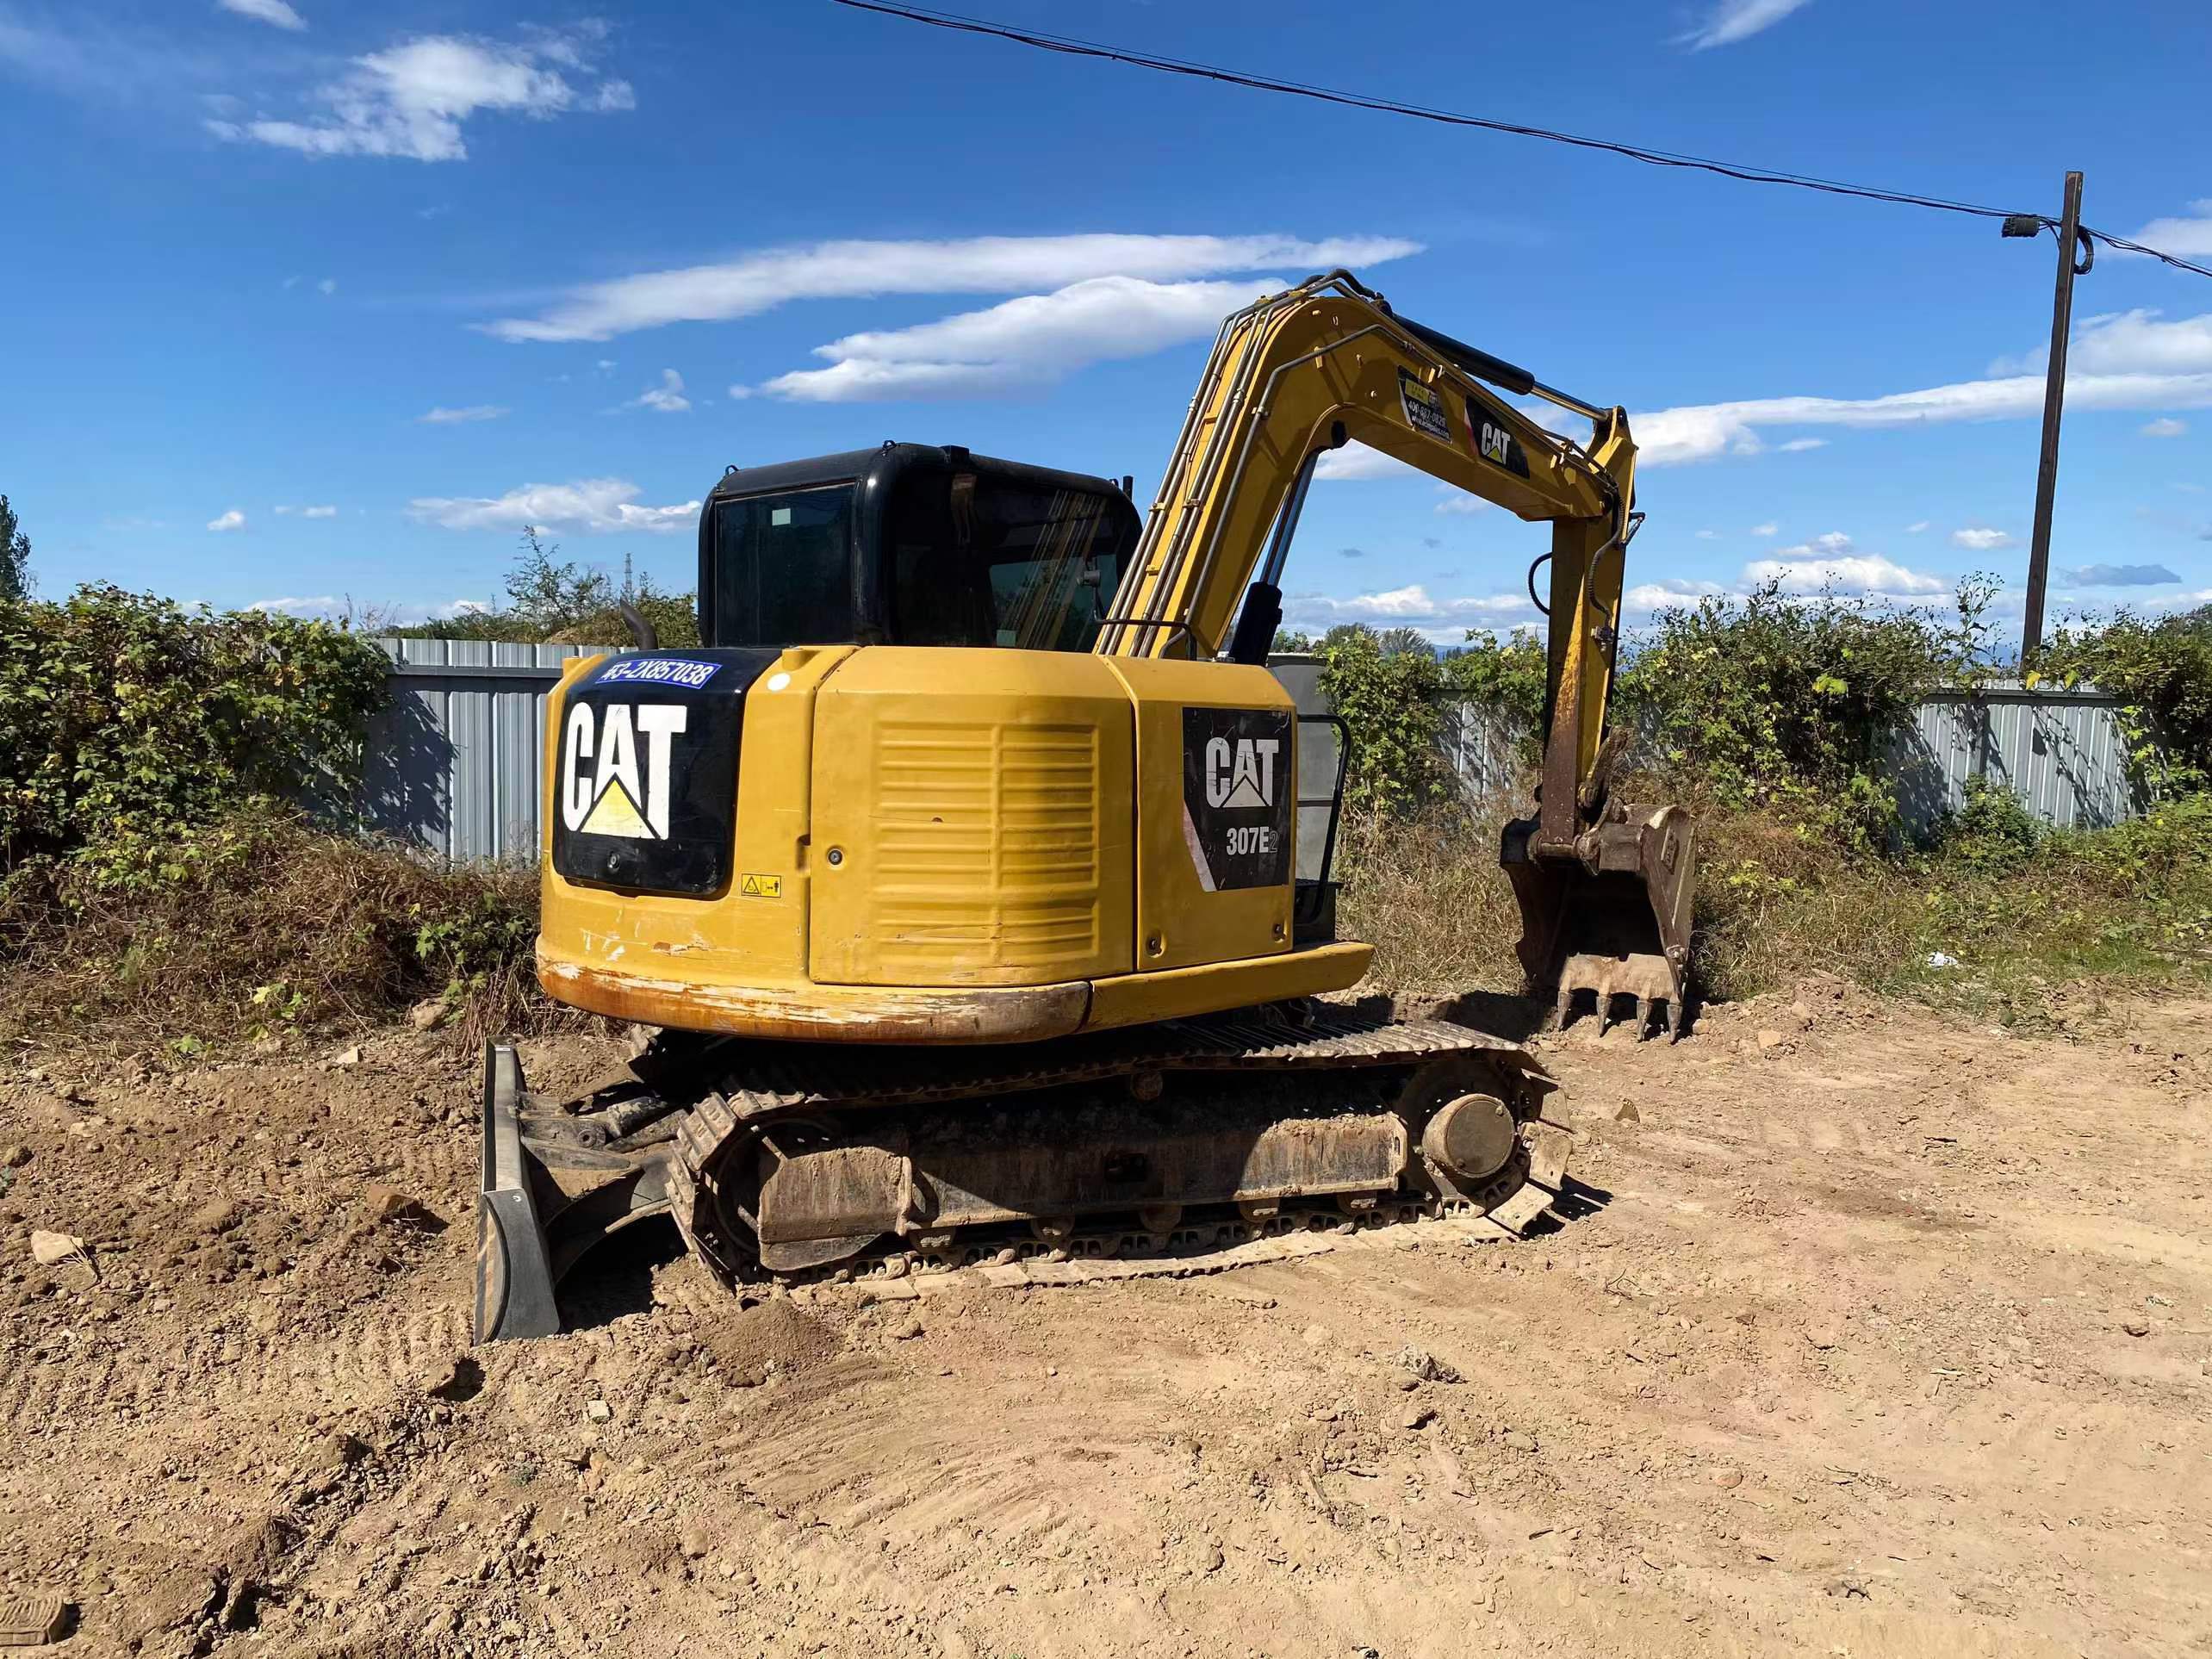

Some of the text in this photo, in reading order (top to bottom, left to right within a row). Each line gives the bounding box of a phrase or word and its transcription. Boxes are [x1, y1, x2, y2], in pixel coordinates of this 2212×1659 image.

[1482, 422, 1511, 465] CAT
[562, 702, 687, 841] CAT
[1206, 737, 1279, 808] CAT
